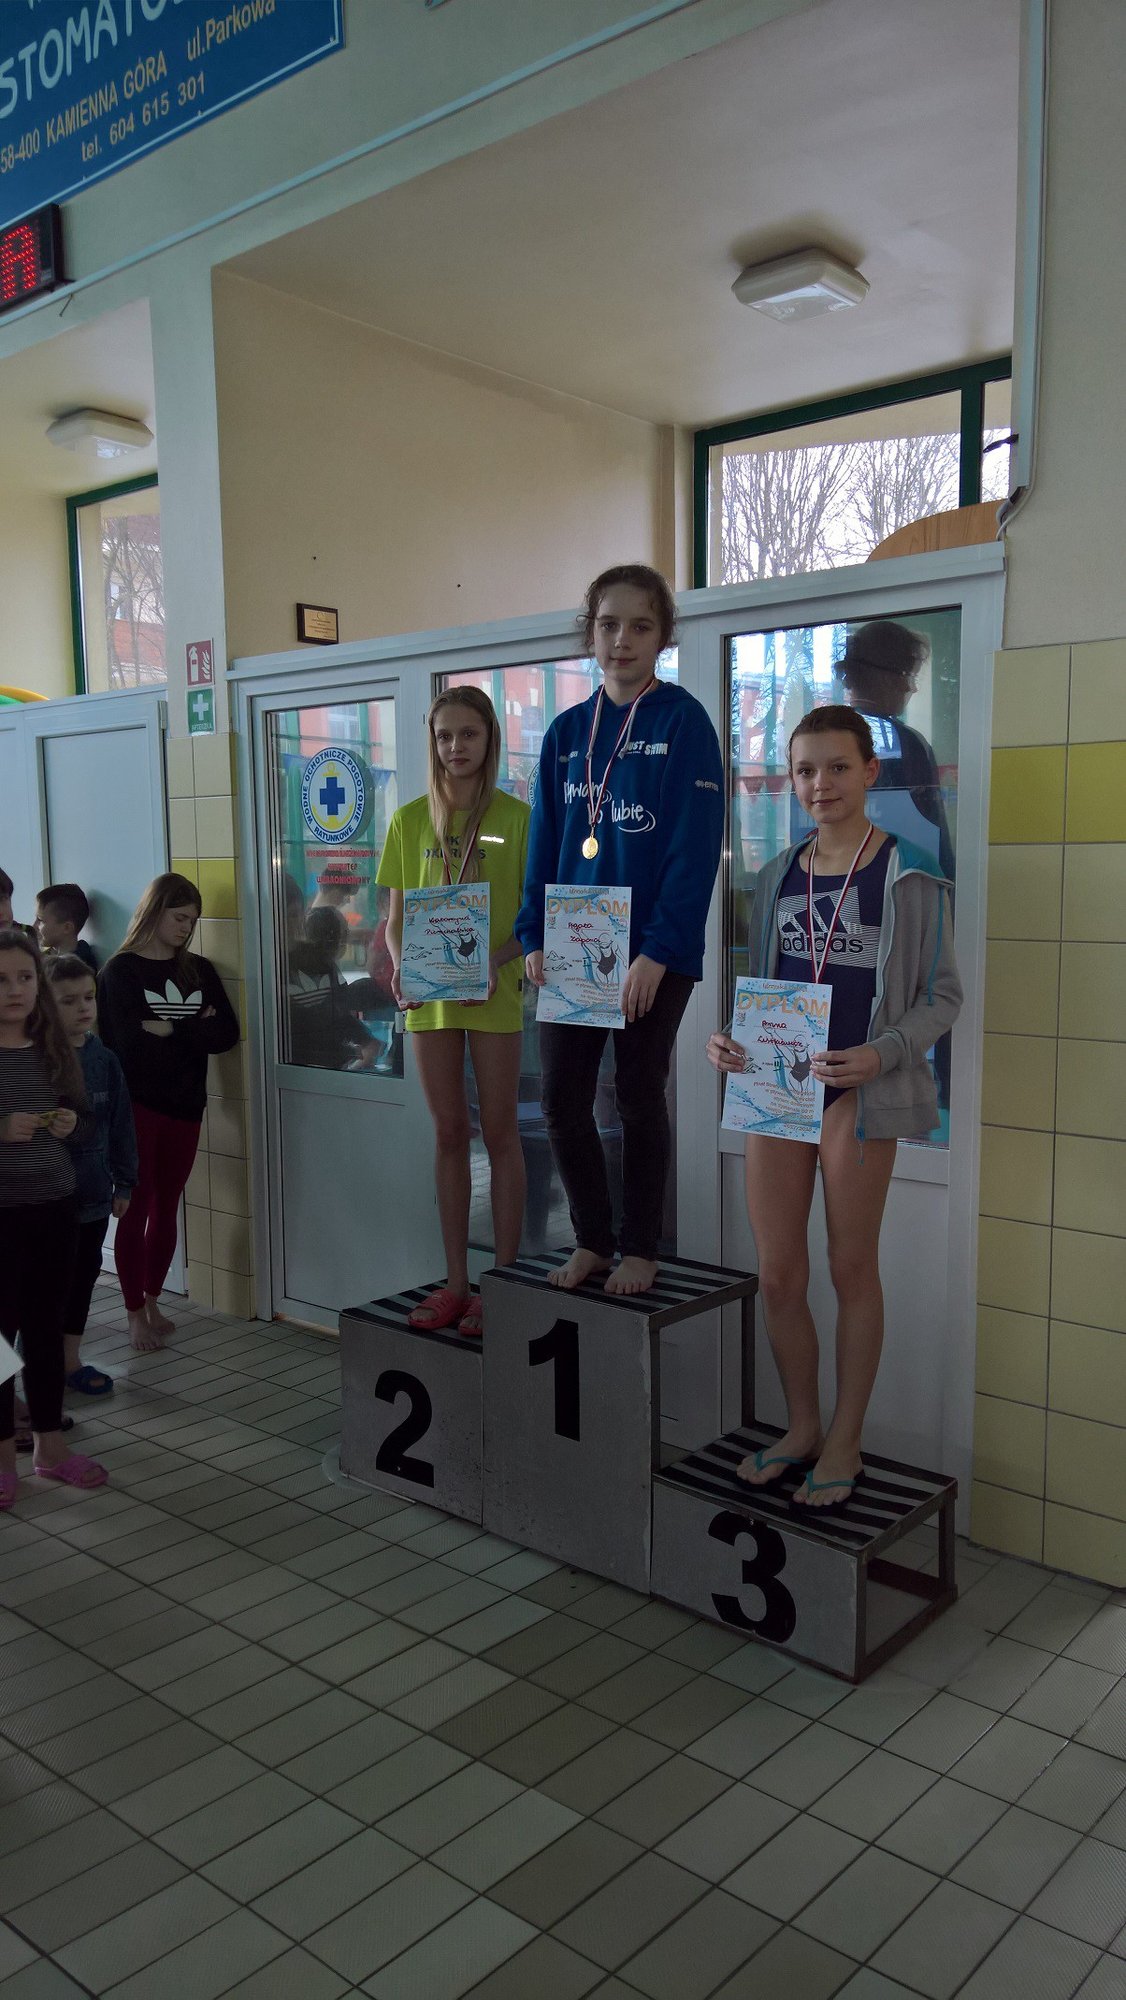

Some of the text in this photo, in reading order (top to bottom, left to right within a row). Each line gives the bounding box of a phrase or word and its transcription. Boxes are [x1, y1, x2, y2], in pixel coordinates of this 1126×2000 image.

[0, 0, 181, 119] STOMAT
[1, 128, 41, 174] 58-400
[46, 85, 118, 148] KAMIENNA
[123, 50, 168, 100] GÓRA
[81, 71, 206, 162] tel. 604 615 301
[304, 749, 347, 781] OCHOTNICZE
[644, 743, 669, 756] SWIM
[302, 786, 313, 825] WODNE
[348, 760, 366, 823] POGOTOWIE
[314, 825, 355, 843] RATUNKOWE
[406, 895, 487, 914] DYPLOM
[547, 898, 629, 918] DYPLOM
[782, 932, 864, 953] adidas
[737, 992, 829, 1020] DYPLOM
[529, 1318, 580, 1441] 1
[374, 1369, 435, 1488] 2
[707, 1510, 797, 1643] 3
